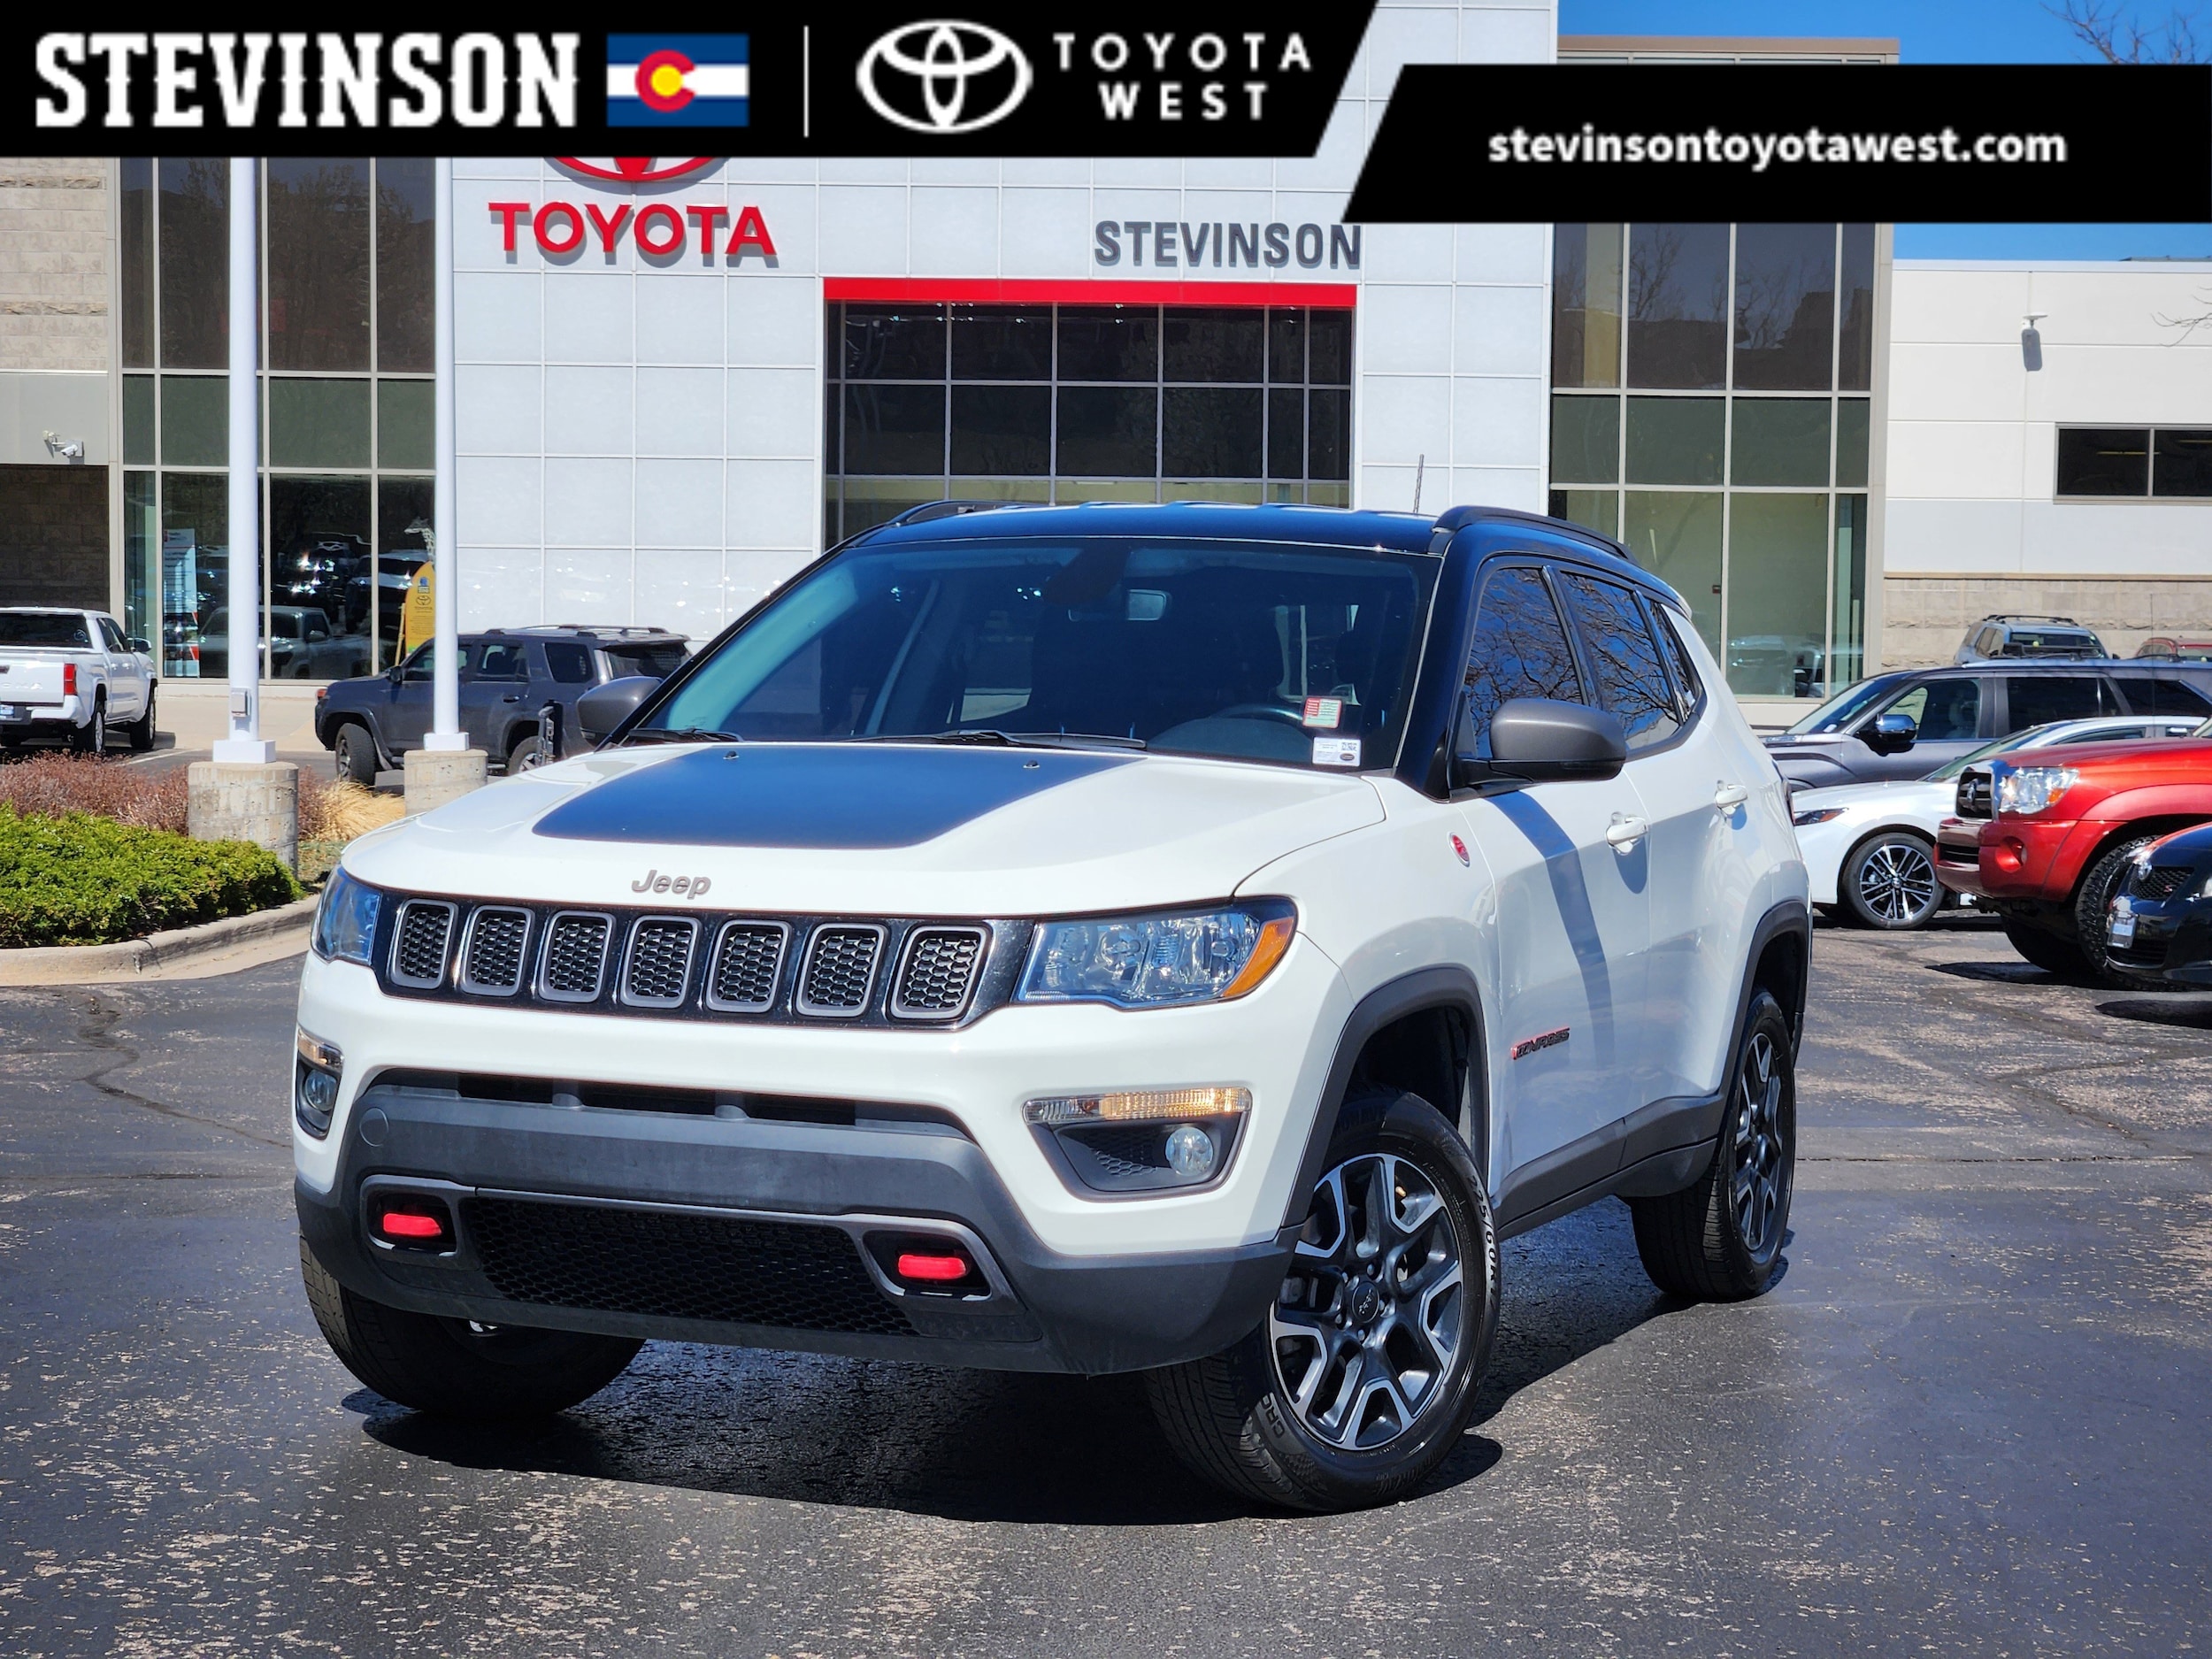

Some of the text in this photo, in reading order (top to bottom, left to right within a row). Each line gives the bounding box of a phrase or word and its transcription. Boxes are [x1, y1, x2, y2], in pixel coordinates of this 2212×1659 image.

[488, 202, 777, 257] TOYOTA
[1095, 221, 1361, 268] STEVINSON
[631, 869, 712, 900] Jeep
